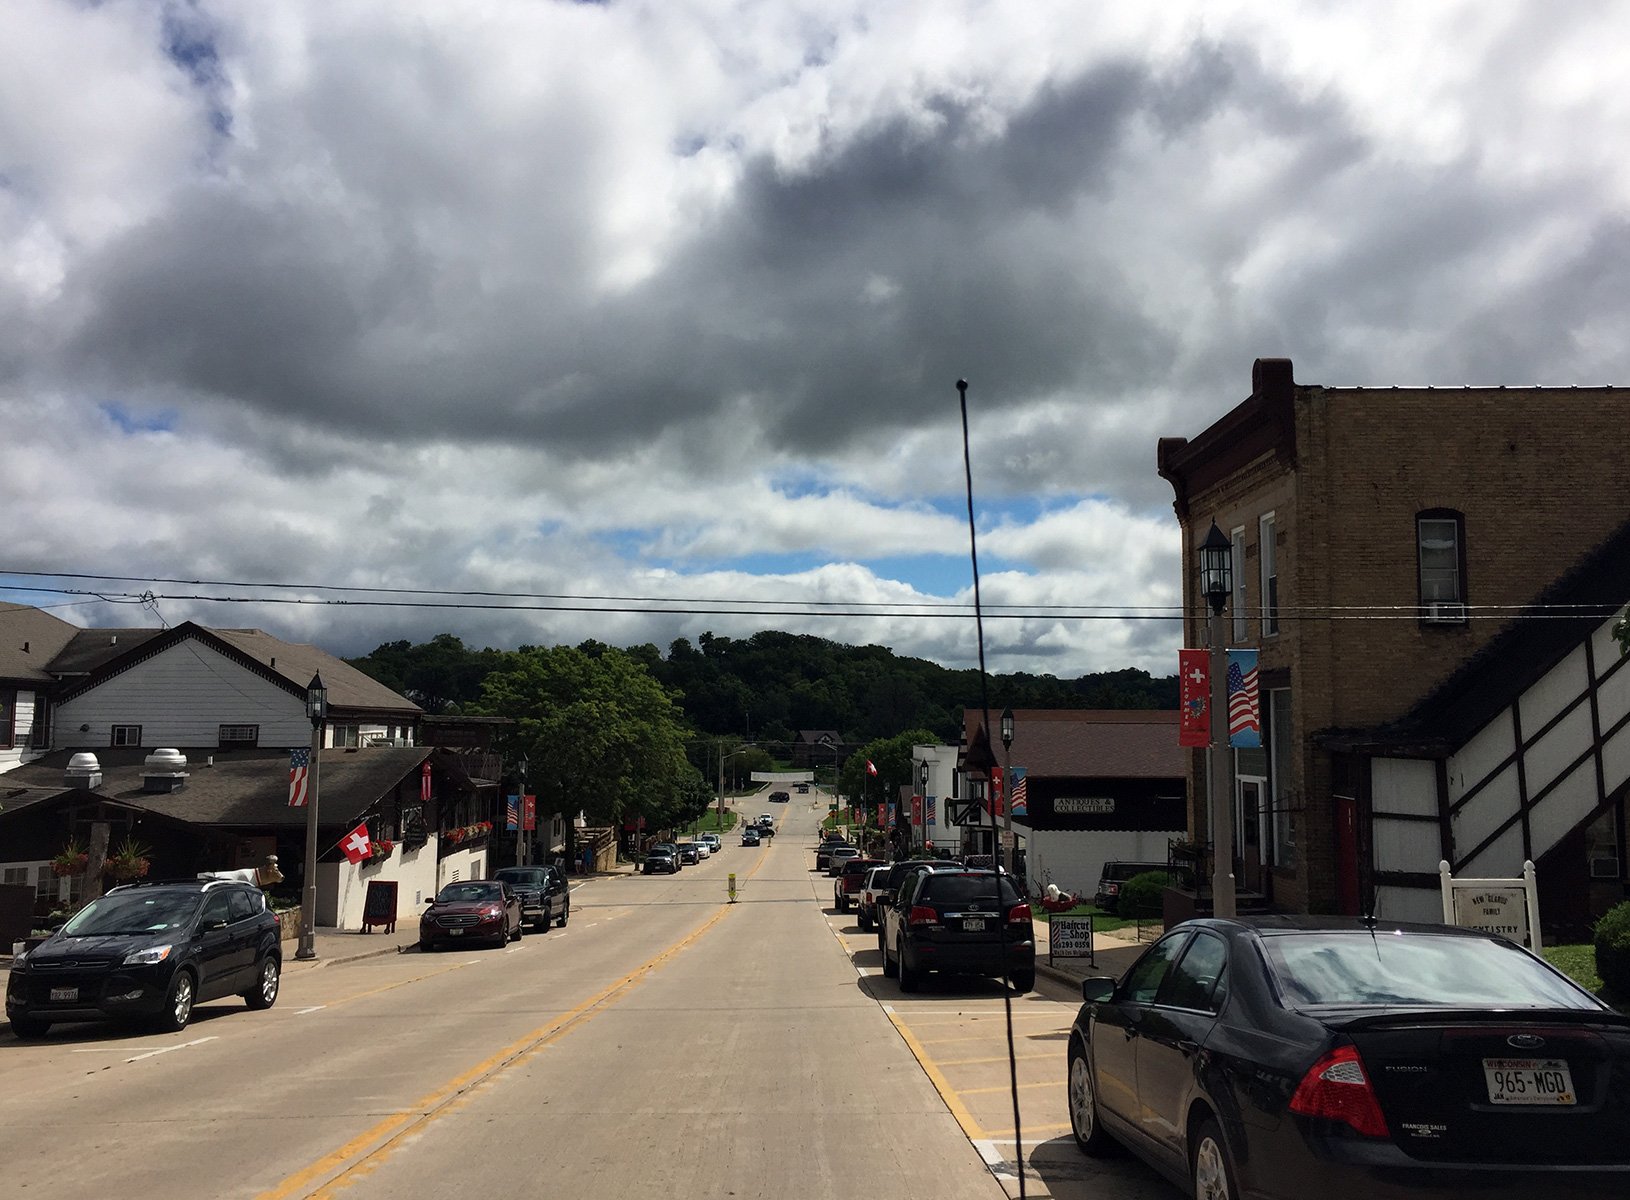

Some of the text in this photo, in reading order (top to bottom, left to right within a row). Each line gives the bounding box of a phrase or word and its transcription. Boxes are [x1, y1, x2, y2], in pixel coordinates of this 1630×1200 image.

[1472, 896, 1485, 905] NEW
[1061, 920, 1089, 930] Haircut
[1070, 929, 1090, 941] Shop
[1385, 1065, 1428, 1073] FUSION
[1494, 1071, 1566, 1094] 965-MGD
